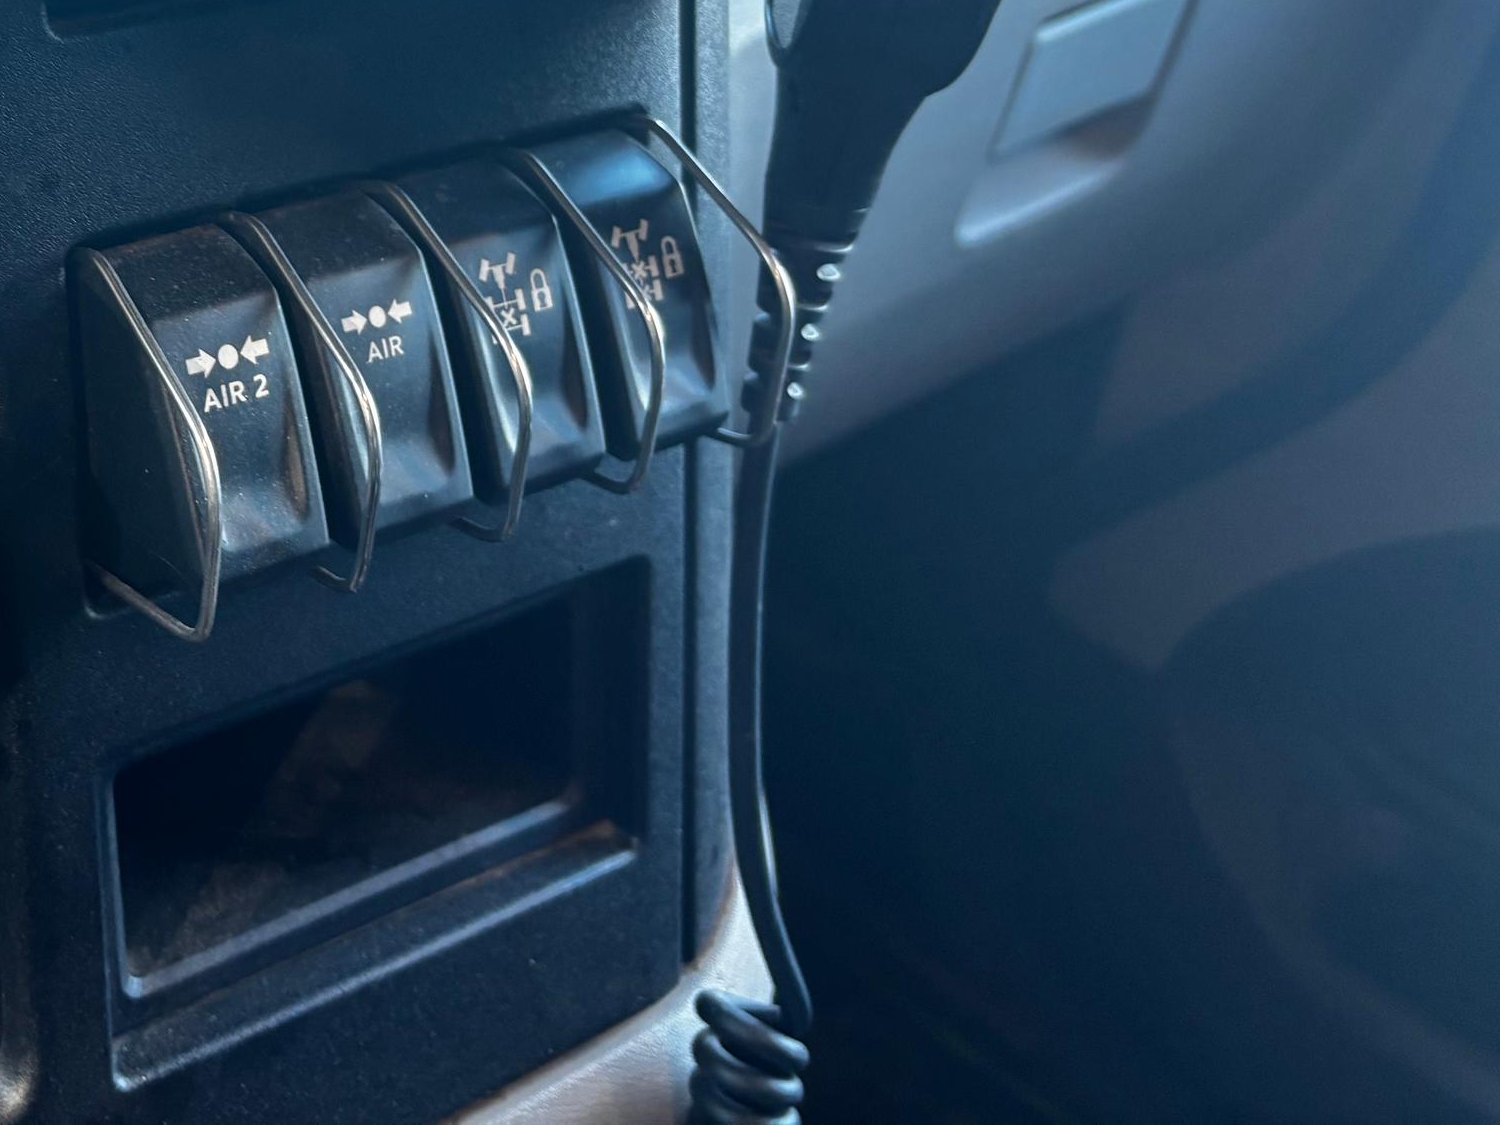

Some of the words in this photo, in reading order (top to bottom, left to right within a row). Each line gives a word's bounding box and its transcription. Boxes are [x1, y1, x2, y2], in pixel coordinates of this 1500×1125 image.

[367, 335, 403, 363] AIR
[203, 380, 248, 413] AIR
[252, 374, 269, 399] 2
